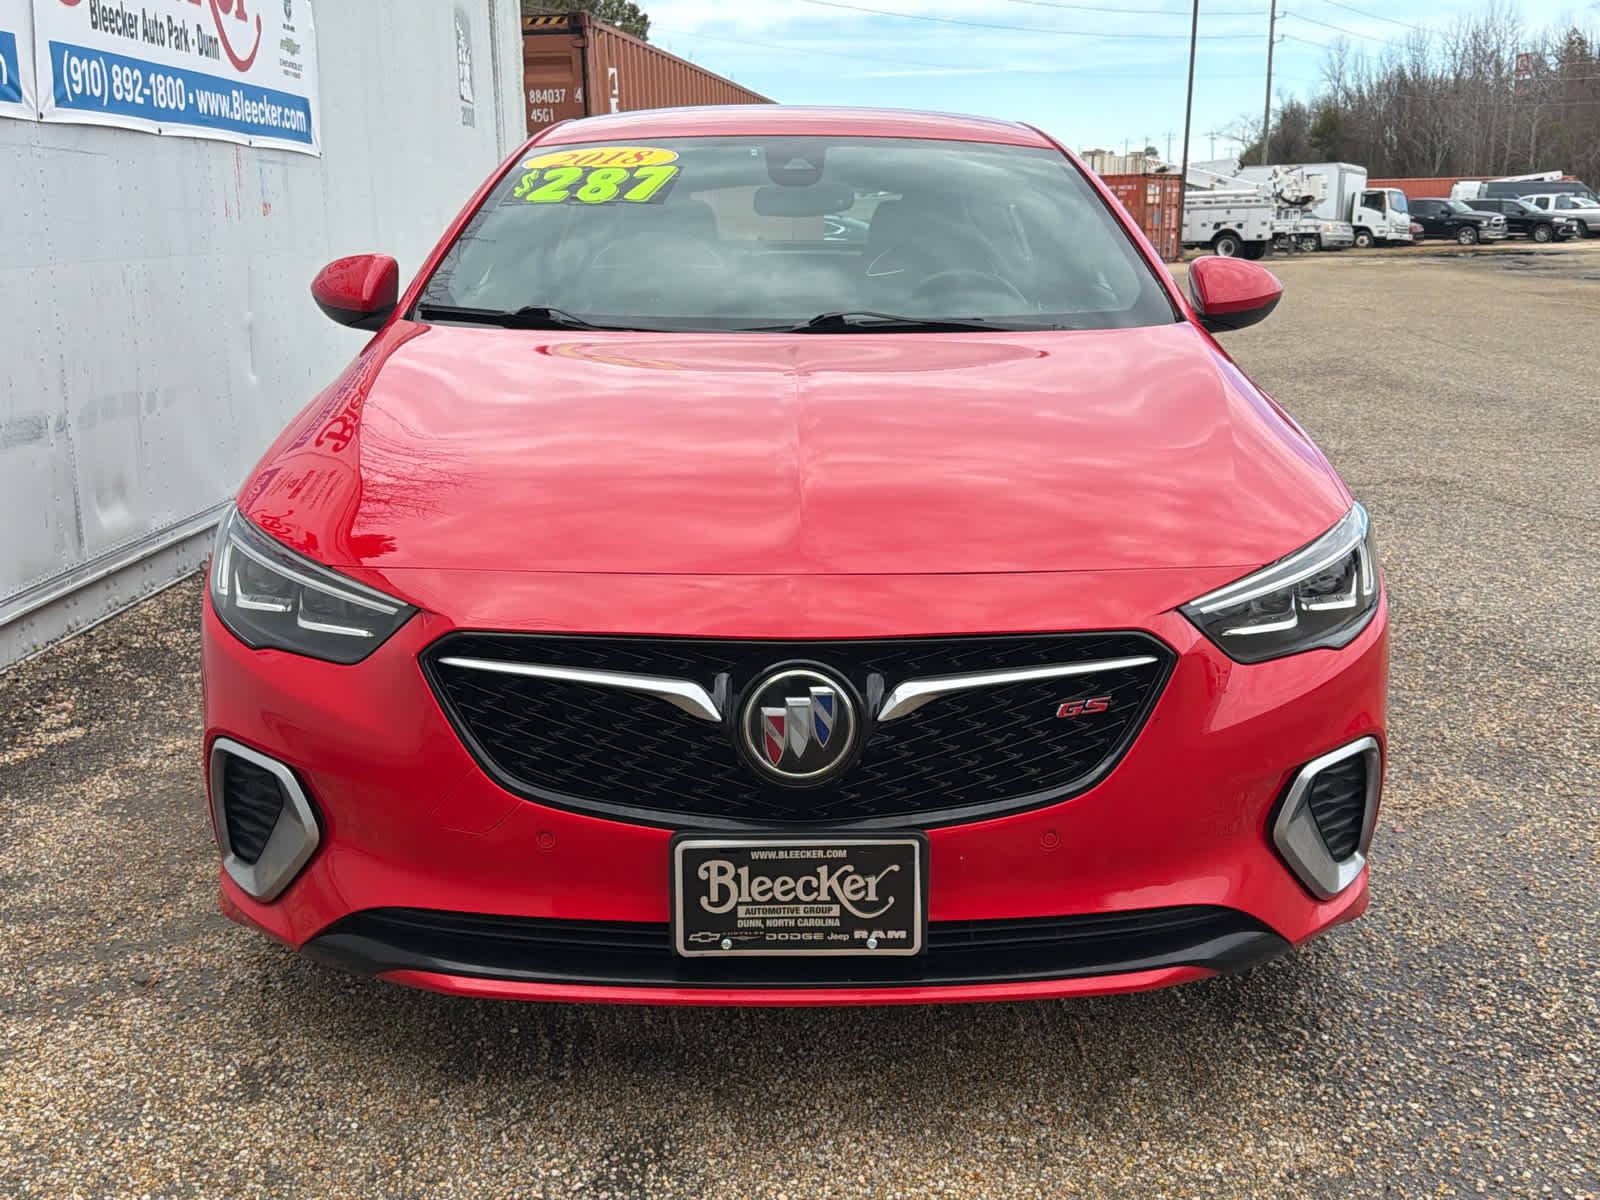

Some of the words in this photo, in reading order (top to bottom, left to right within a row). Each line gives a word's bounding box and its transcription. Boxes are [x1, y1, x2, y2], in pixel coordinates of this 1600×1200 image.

[89, 0, 139, 41] Bleecker
[142, 8, 165, 48] Auto
[167, 15, 191, 53] Park
[196, 23, 220, 61] Dunn
[63, 50, 108, 106] (910)
[112, 64, 185, 111] 892-1800
[196, 89, 306, 132] www.Bleecker.com
[529, 88, 566, 104] 884037
[531, 108, 554, 122] 45G1
[549, 150, 654, 168] 2018
[513, 165, 680, 203] $287
[1056, 696, 1112, 718] GS
[751, 850, 847, 860] WWW.BLEECKER.COM
[744, 906, 801, 916] AUTOMOTIVE
[803, 906, 833, 915] GROUP
[737, 919, 764, 929] DUNN,
[766, 919, 795, 928] NORTH
[797, 918, 841, 927] CAROLINA
[765, 932, 824, 941] DODGE
[827, 932, 850, 942] Jeep
[853, 930, 907, 939] RAM
